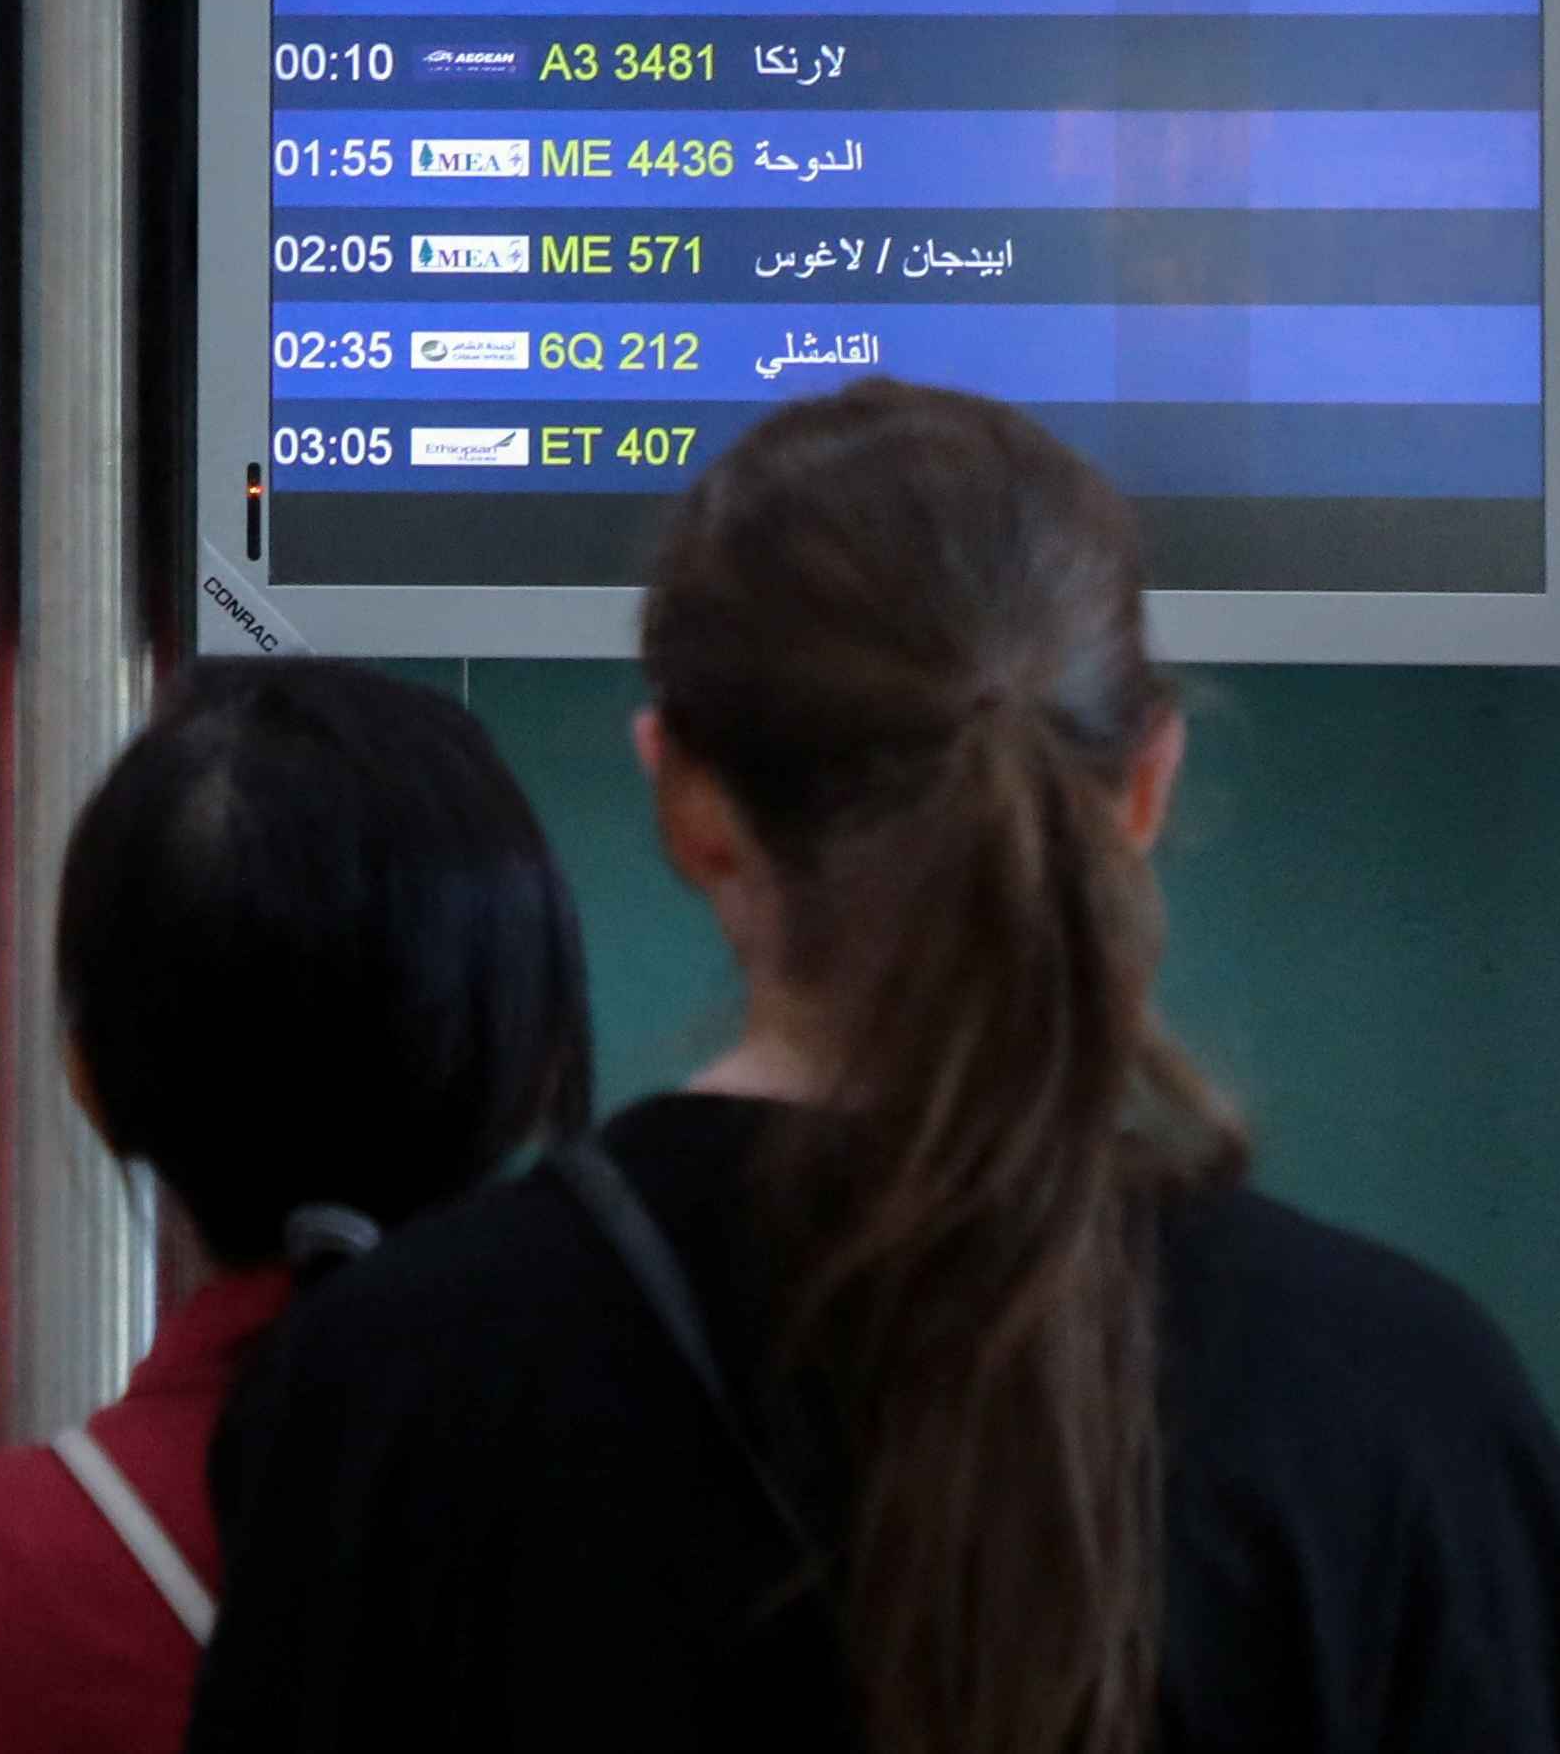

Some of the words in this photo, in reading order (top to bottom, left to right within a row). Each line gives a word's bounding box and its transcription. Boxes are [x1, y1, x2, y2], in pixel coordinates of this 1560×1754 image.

[274, 139, 393, 177] 01:55
[542, 139, 613, 177] ME
[627, 139, 733, 177] 4436
[274, 235, 393, 273] 02:05
[542, 235, 612, 273] ME
[628, 236, 700, 274] 571
[437, 249, 501, 267] MEA
[755, 238, 864, 279] لاغوس
[876, 237, 891, 274] /
[903, 238, 1013, 278] ابيدجان
[274, 331, 393, 369] 02:35
[539, 332, 604, 372] 6Q
[619, 332, 699, 370] 212
[755, 332, 879, 379] القامشلي
[273, 427, 393, 466] 03:05
[542, 427, 603, 465] ET
[616, 427, 696, 466] 407
[202, 576, 279, 654] CONRAC
